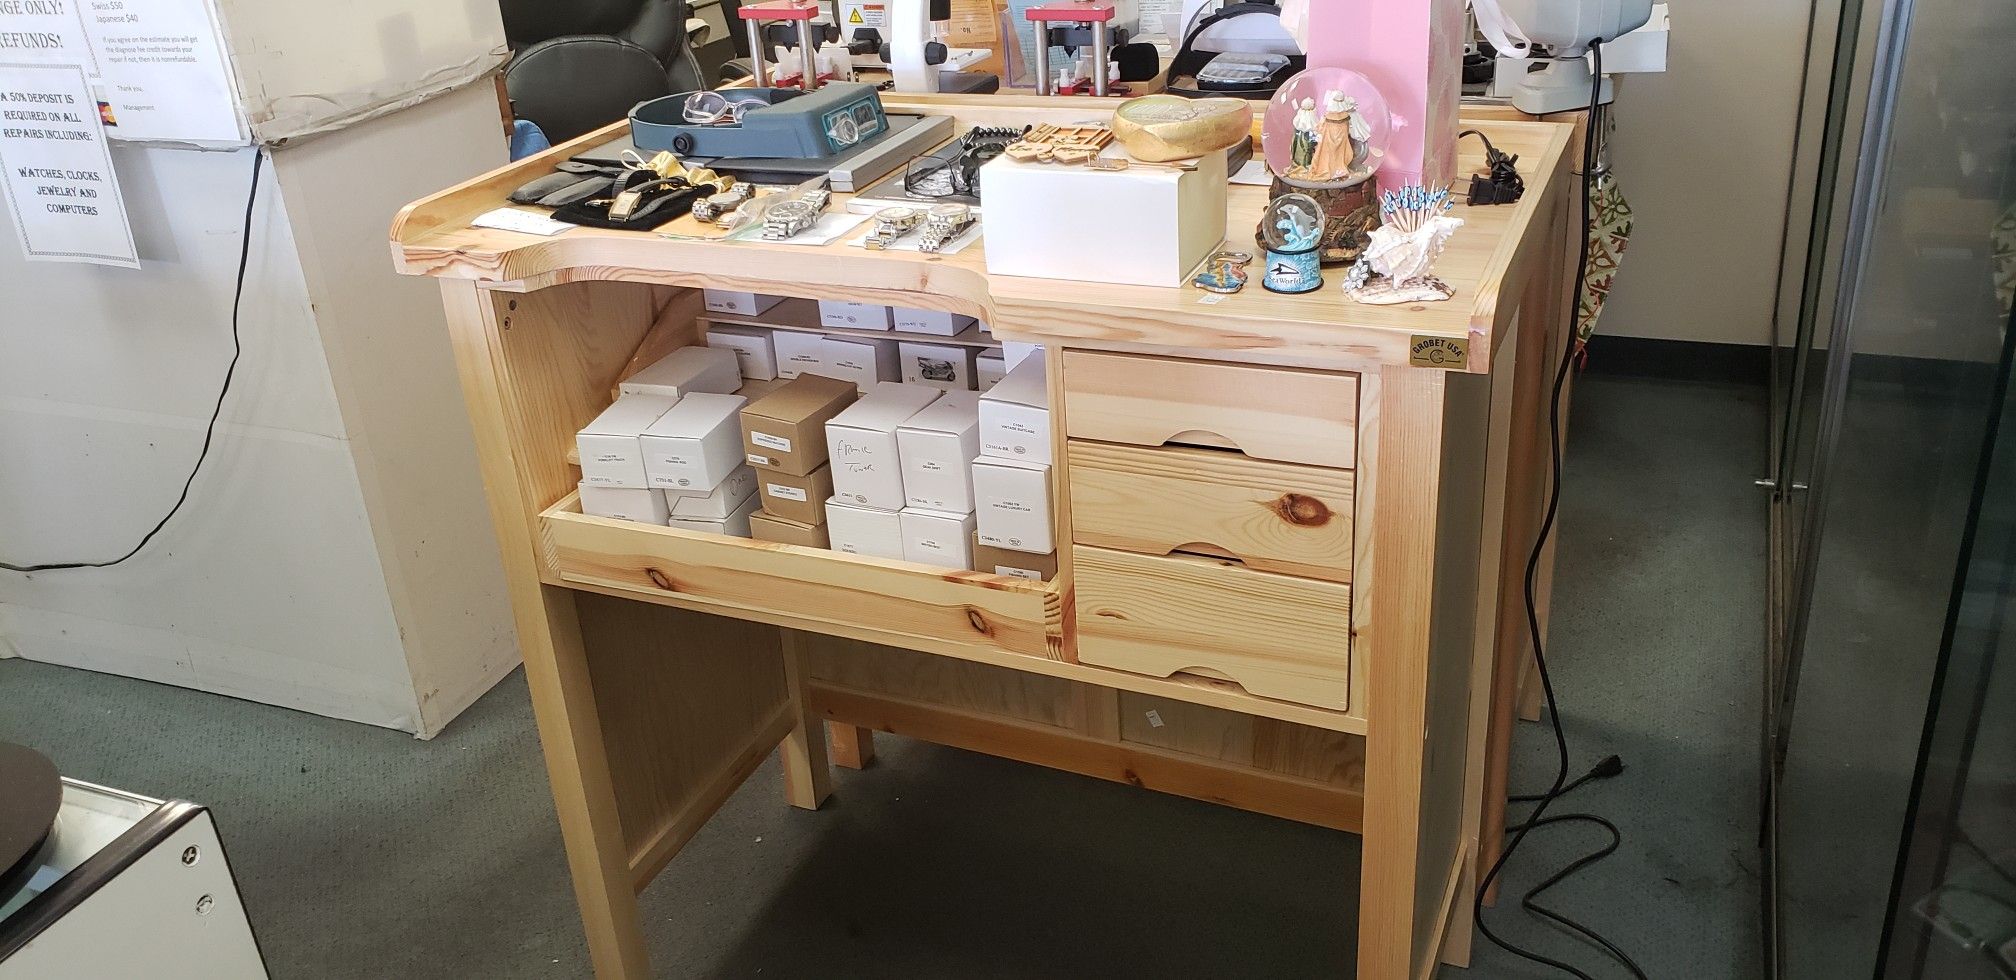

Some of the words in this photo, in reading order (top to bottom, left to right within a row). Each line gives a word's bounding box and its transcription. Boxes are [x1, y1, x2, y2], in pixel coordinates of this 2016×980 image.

[25, 0, 64, 15] ONLY!
[110, 1, 123, 10] $50
[96, 15, 125, 23] Japanese
[126, 14, 139, 22] $40
[0, 32, 64, 48] EFUNDS!
[0, 92, 8, 101] A
[10, 92, 27, 102] 50%
[27, 93, 63, 104] DEPOSIT
[64, 94, 75, 104] IS
[4, 110, 48, 121] REQUIRED
[49, 112, 61, 121] ON
[63, 112, 81, 122] ALL
[3, 128, 44, 138] REPAIRS
[45, 130, 93, 141] INCLUDING:
[18, 167, 66, 180] WATCHES,
[66, 170, 102, 183] CLOCKS,
[37, 185, 77, 197] JEWELRY
[80, 188, 97, 198] AND
[46, 203, 98, 216] COMPUTERS
[1412, 339, 1445, 354] GROBET
[1447, 342, 1462, 357] USA
